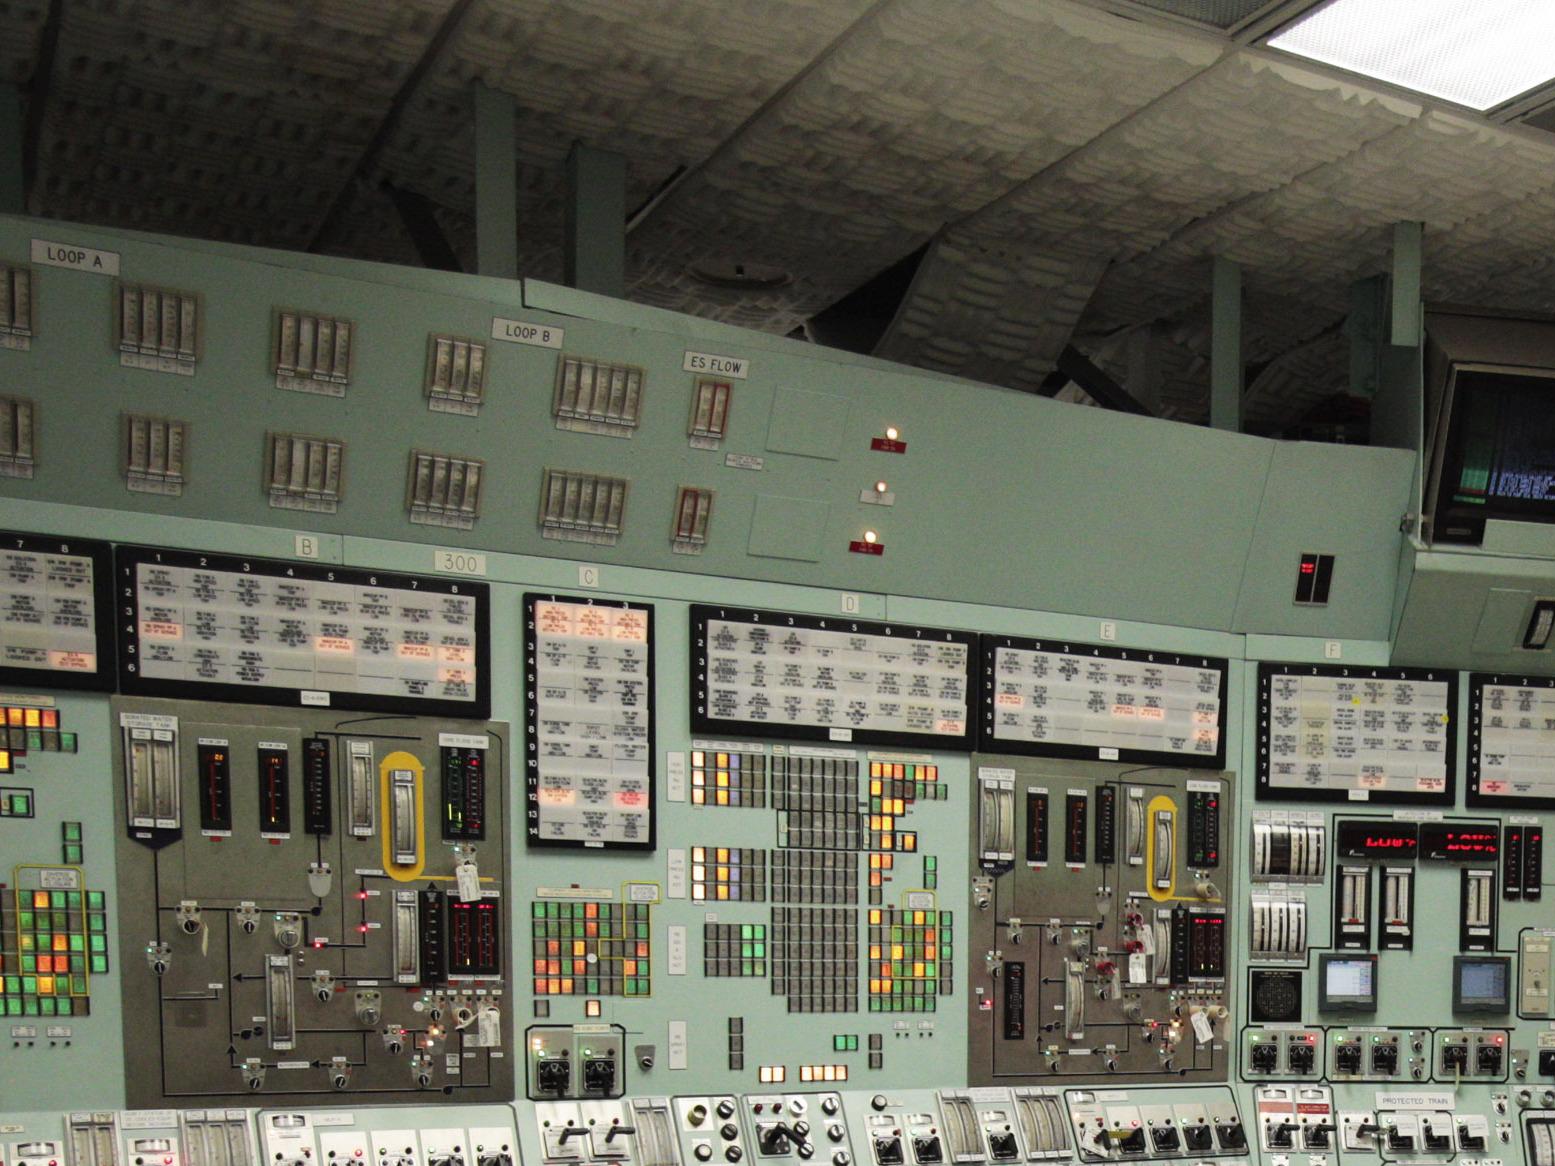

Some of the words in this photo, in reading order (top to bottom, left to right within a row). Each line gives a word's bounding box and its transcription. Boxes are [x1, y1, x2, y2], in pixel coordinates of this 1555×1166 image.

[47, 247, 86, 265] LOOP
[93, 255, 103, 269] A
[505, 325, 537, 341] LOOP
[543, 331, 550, 343] B
[691, 356, 706, 370] ES
[711, 359, 742, 373] FLOW
[302, 538, 312, 556] B
[444, 553, 477, 572] 300
[244, 563, 249, 571] 3
[370, 577, 376, 585] 6
[584, 569, 594, 585] C
[126, 588, 131, 596] 2
[126, 607, 132, 615] 3
[846, 596, 855, 611] D
[1104, 624, 1111, 639] E
[129, 645, 135, 653] 5
[1329, 644, 1337, 656] F
[1382, 1097, 1424, 1105] PROTECTED
[1428, 1097, 1448, 1105] TRAIN
